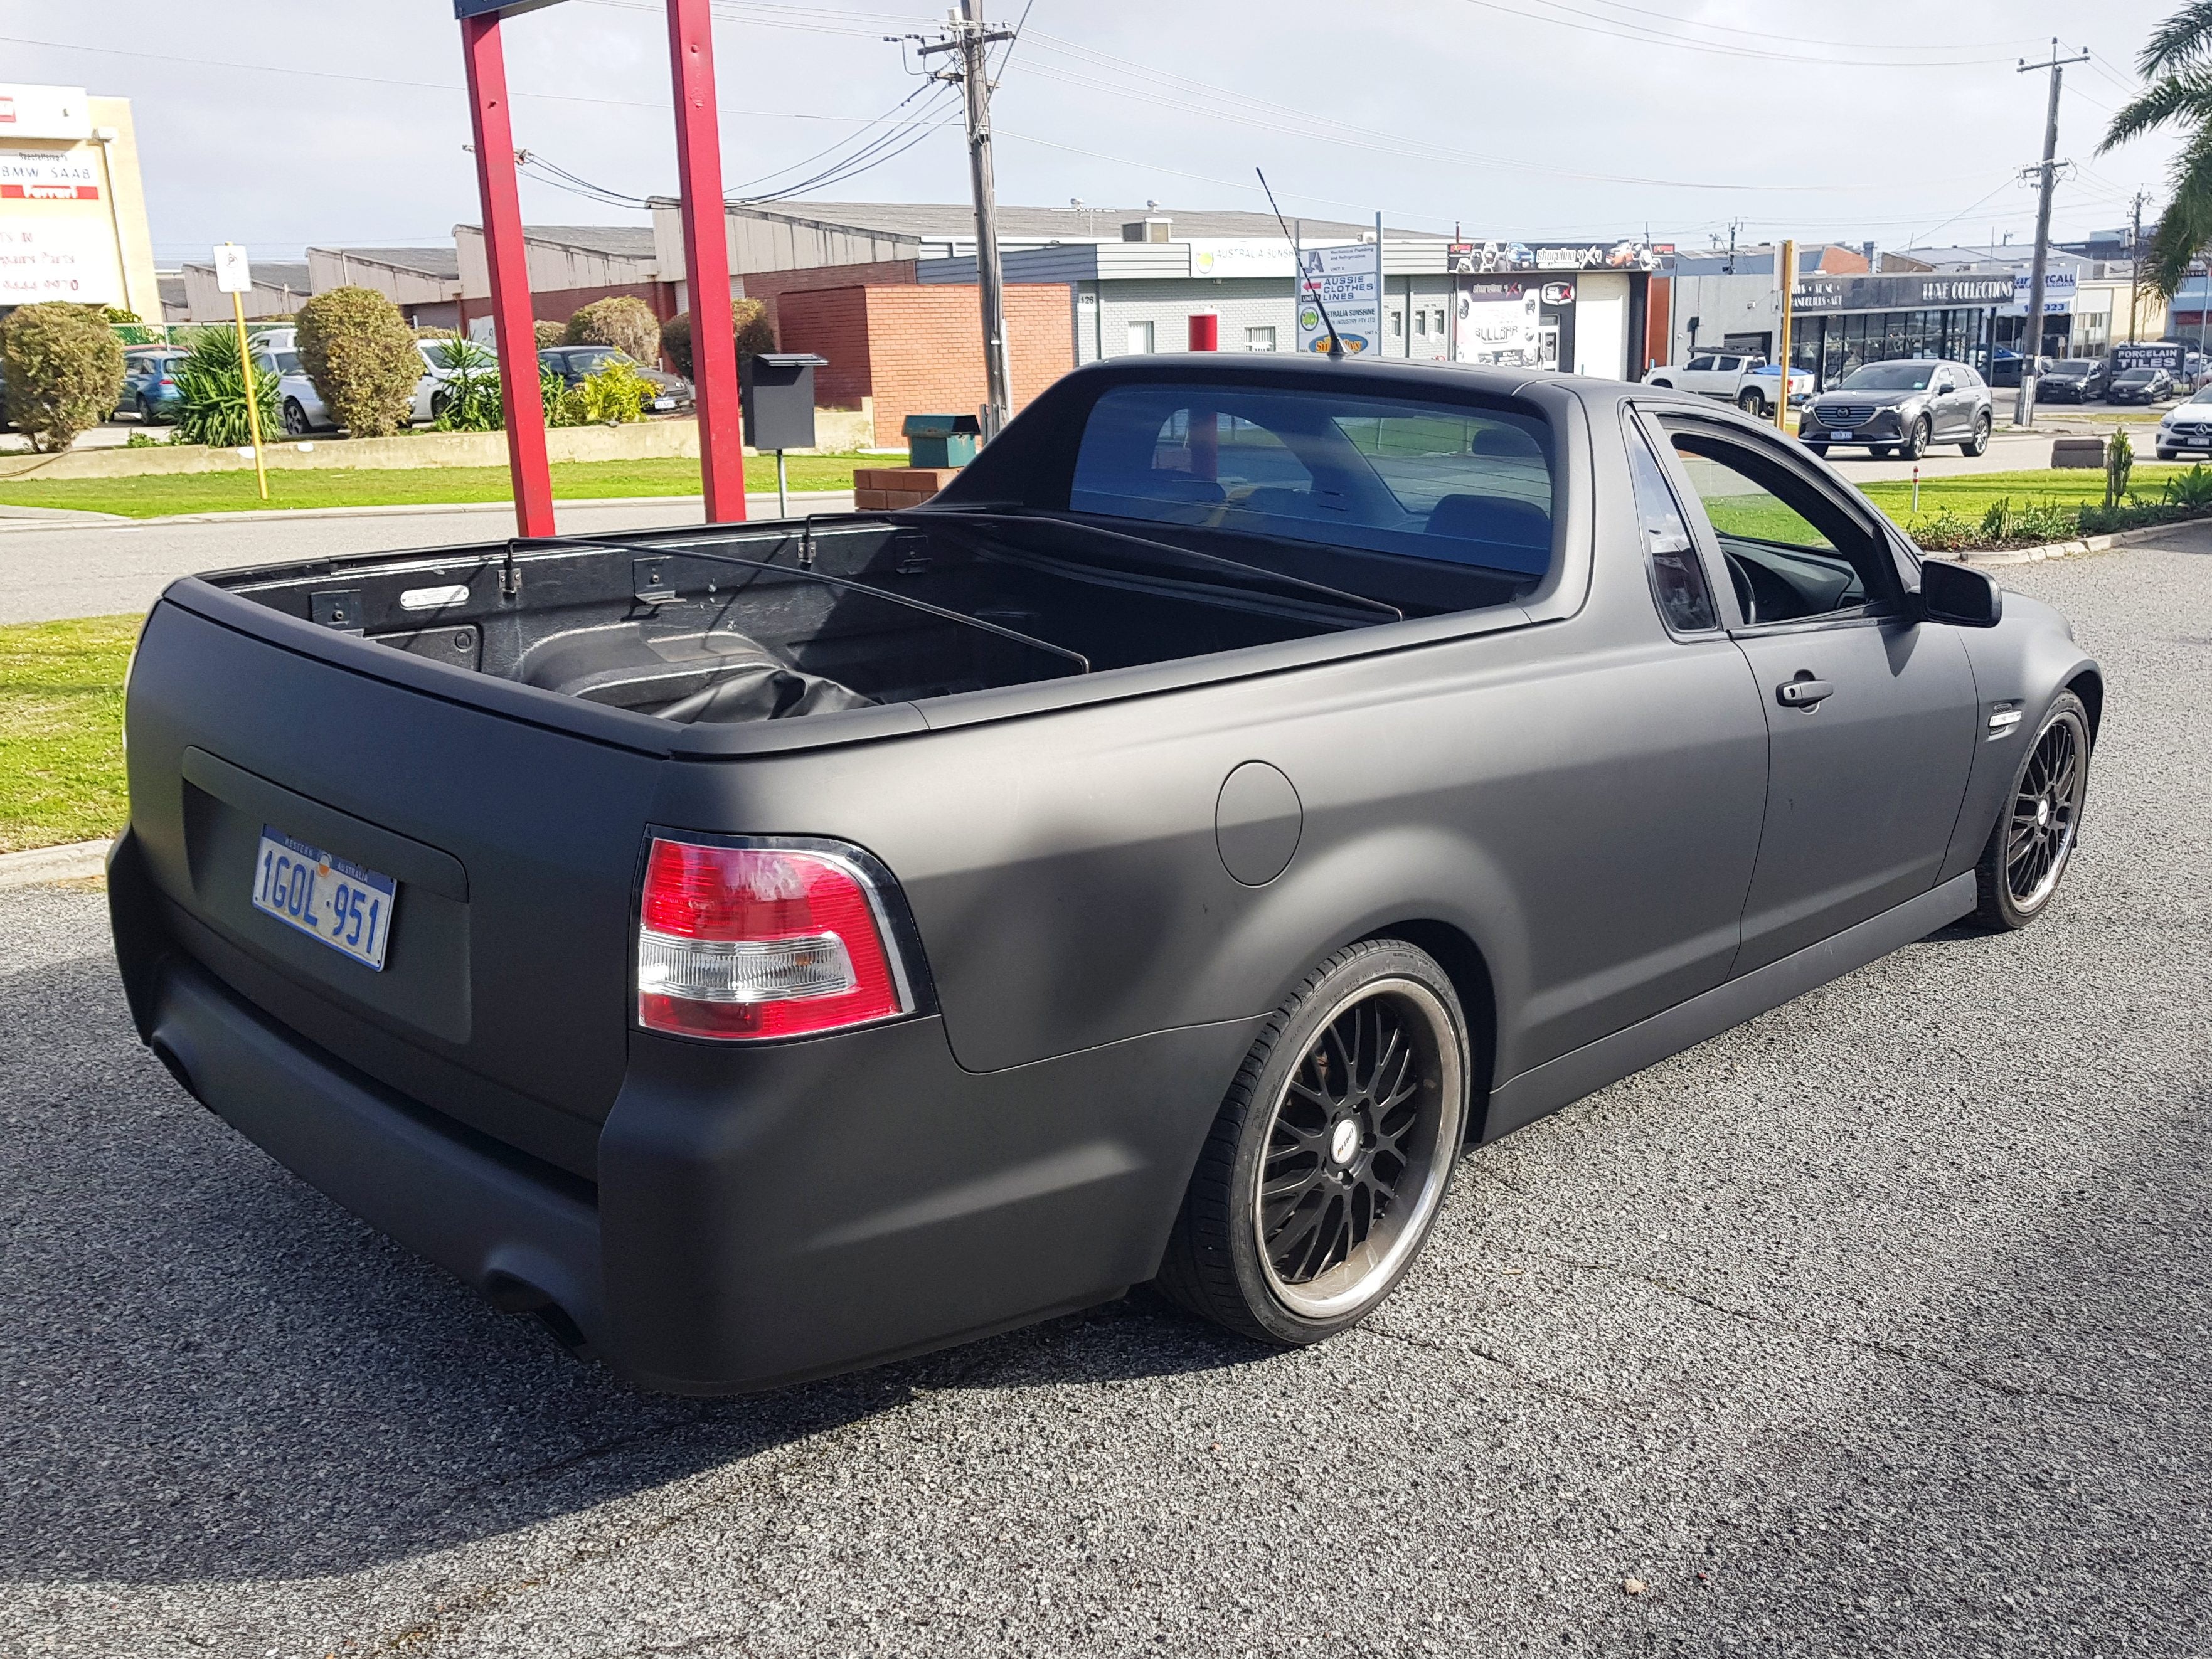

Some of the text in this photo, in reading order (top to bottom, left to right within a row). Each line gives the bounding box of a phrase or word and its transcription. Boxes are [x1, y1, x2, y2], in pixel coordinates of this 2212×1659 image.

[1, 166, 91, 179] BMW SAAB
[23, 184, 77, 198] Ferrari
[1216, 248, 1263, 258] AUSTRALIA
[1537, 248, 1576, 262] shoreline
[1324, 275, 1364, 285] AUSSIE
[1323, 283, 1373, 294] CLOTHES
[1922, 280, 2013, 300] LUXE COLLECTIONS
[1080, 295, 1094, 304] 126
[1322, 292, 1354, 301] LINES
[1349, 308, 1375, 317] SUNSHINE
[2118, 349, 2177, 358] PORCELAIN
[2117, 358, 2176, 368] TILES
[284, 838, 369, 883] WESTERN AUSTRALIA
[262, 850, 380, 955] 1GOL 951
[1337, 1127, 1354, 1157] PETROL
